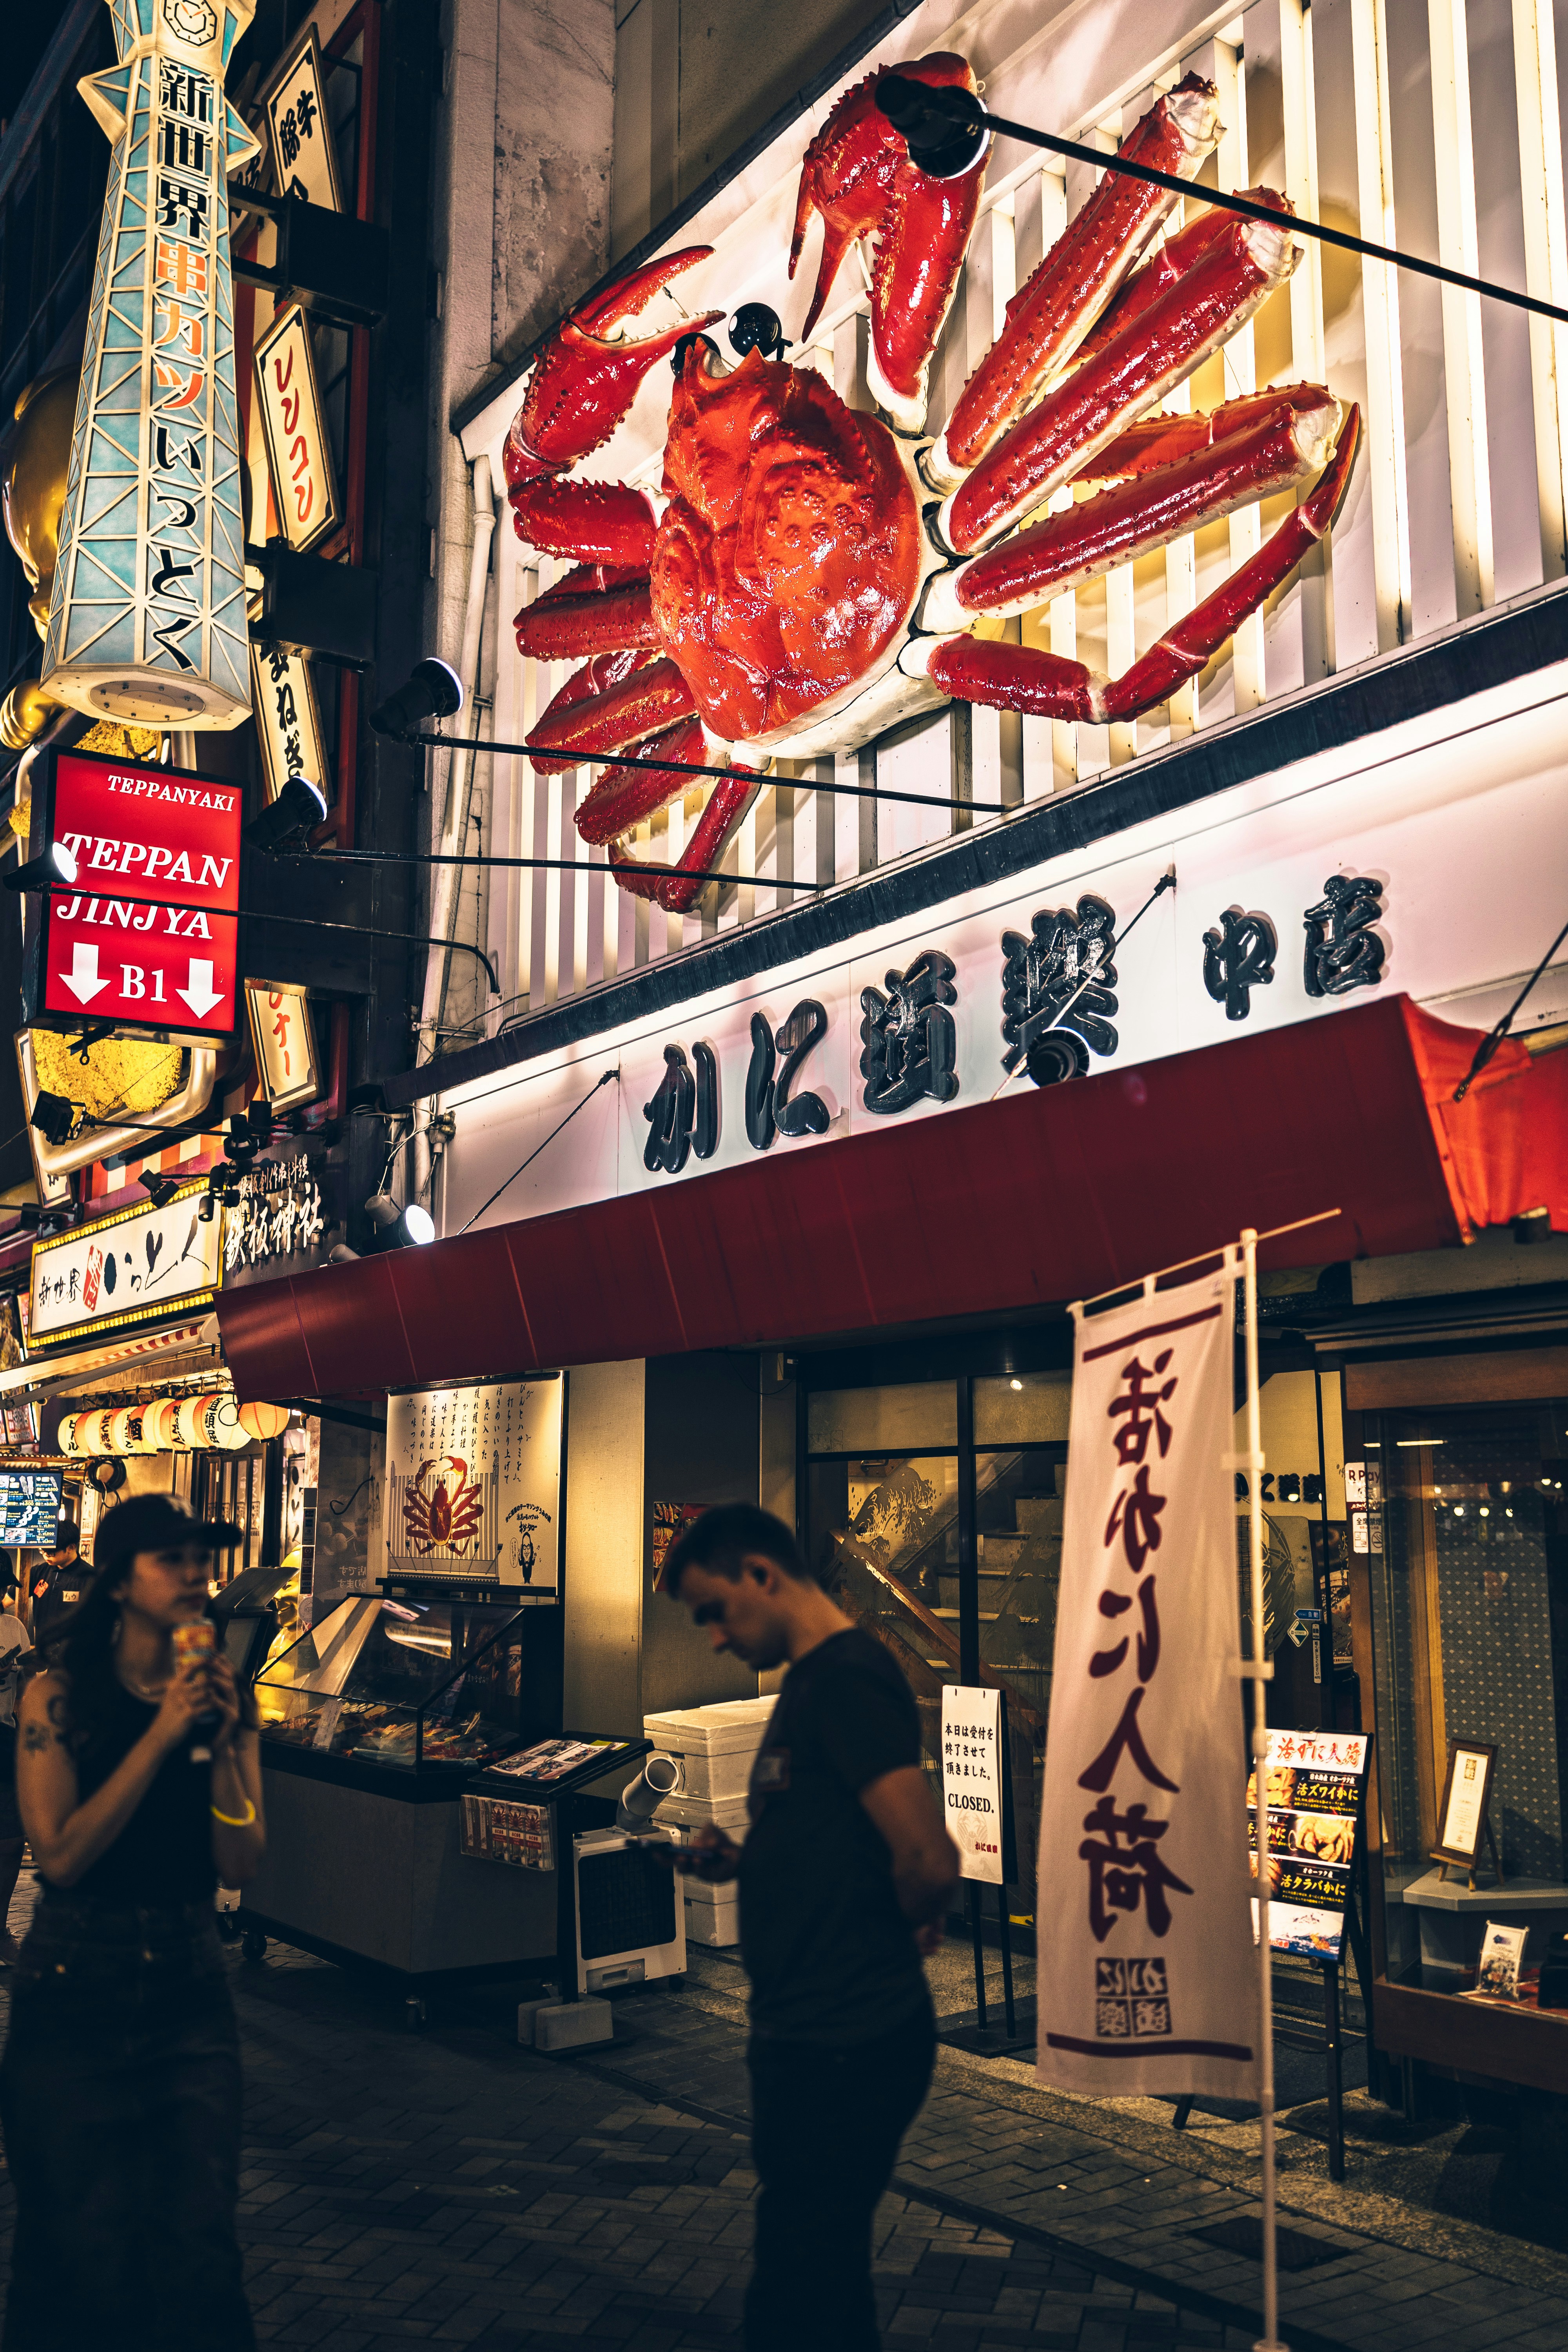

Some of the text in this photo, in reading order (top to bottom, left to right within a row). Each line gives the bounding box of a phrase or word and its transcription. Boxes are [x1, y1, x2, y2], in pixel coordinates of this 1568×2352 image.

[274, 345, 313, 523] レンコン
[108, 775, 235, 812] TEPPANYAKI
[62, 832, 233, 889] TEPPAN
[56, 889, 213, 940] JINJYA
[118, 964, 168, 1002] B1
[644, 875, 1385, 1173] かに道楽 中店
[223, 1183, 323, 1271] 鉄板神社
[39, 1268, 82, 1312] 新世界
[205, 1397, 223, 1443] 道頓堀
[430, 1394, 438, 1450] かに道楽は
[439, 1403, 447, 1461] 味で人よぶ
[450, 1390, 459, 1448] 味で夢よぶ
[482, 1399, 490, 1460] 気に入った
[945, 1722, 993, 1740] 本日は受付を
[945, 1743, 986, 1758] 終了させて
[1278, 1737, 1361, 1767] 活かに入荷
[946, 1762, 991, 1781] 頂きました。
[1297, 1783, 1359, 1800] 活ズワイかに
[948, 1793, 994, 1813] CLOSED.
[1280, 1874, 1346, 1896] 活タラバかに
